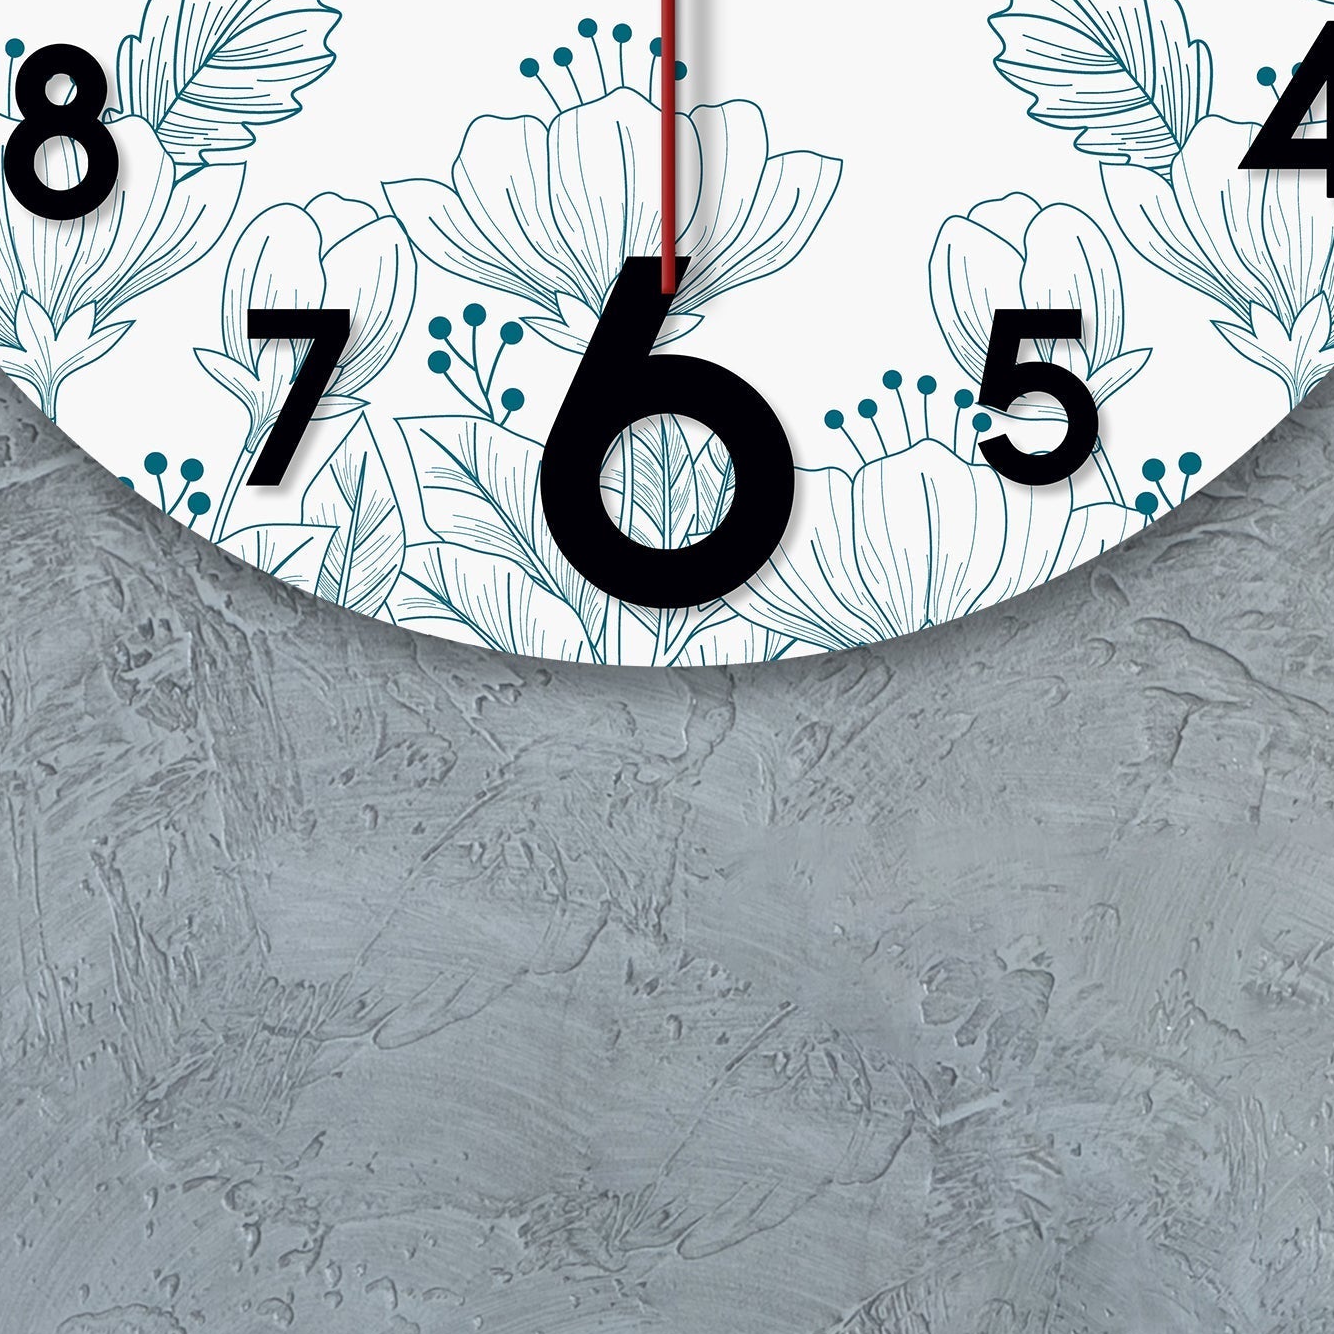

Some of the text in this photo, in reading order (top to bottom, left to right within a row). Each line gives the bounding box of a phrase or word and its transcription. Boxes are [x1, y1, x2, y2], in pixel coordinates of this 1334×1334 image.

[3, 43, 119, 221] 8
[246, 308, 352, 486] 7
[540, 255, 796, 609] 6
[977, 308, 1099, 486] 5
